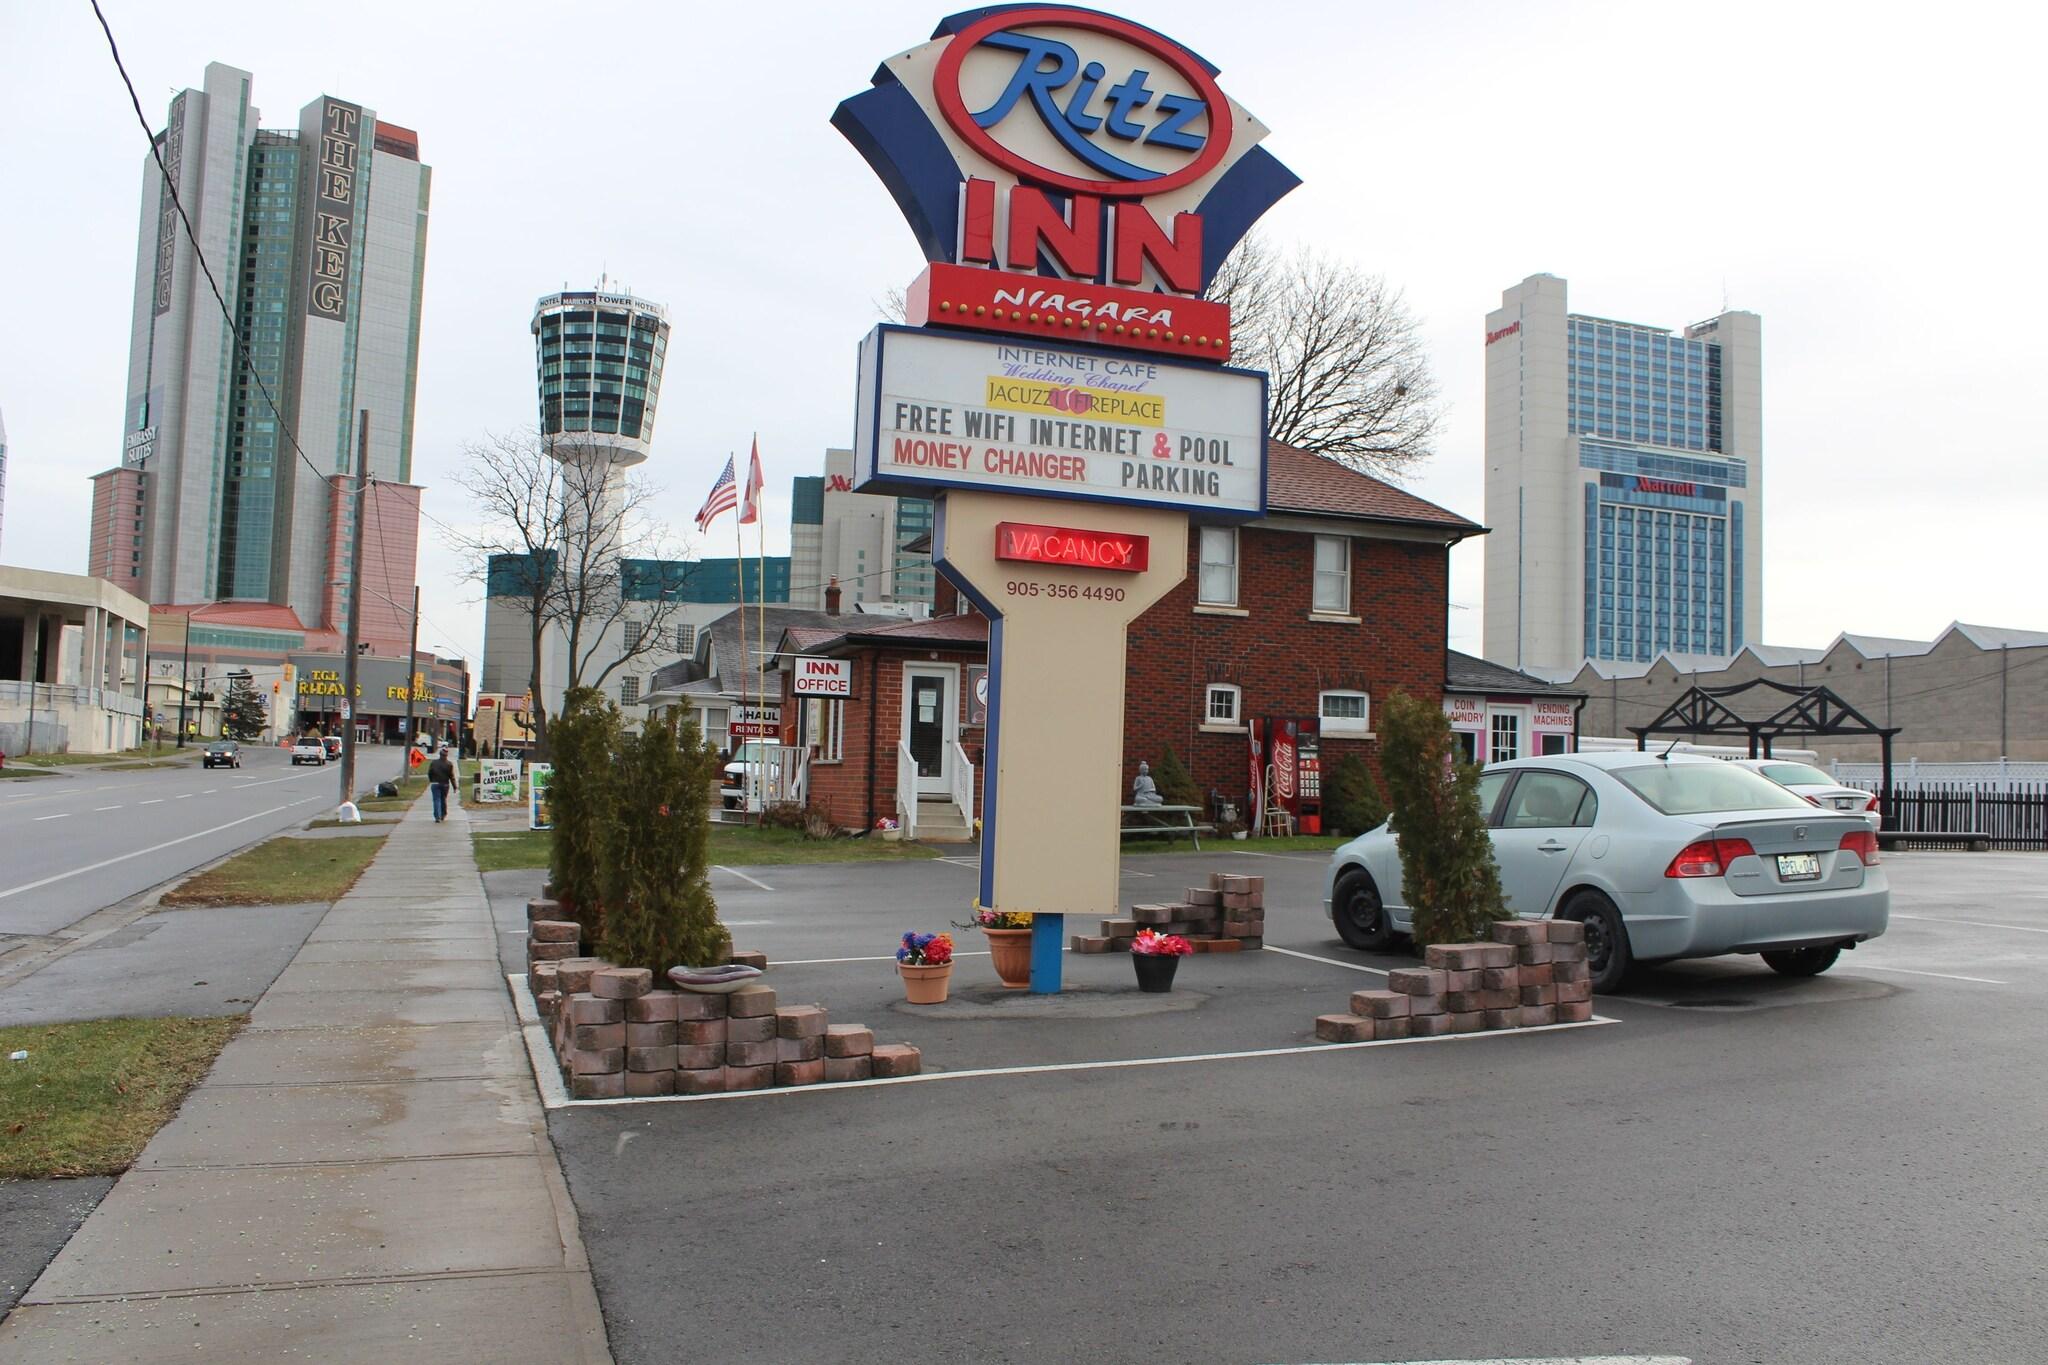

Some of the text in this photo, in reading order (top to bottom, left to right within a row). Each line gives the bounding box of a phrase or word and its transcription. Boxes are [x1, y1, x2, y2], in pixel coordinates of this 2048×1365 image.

[969, 31, 1208, 181] Ritz
[313, 103, 356, 315] THE KEG
[961, 177, 1203, 294] INN
[598, 295, 632, 306] TOWER
[635, 300, 659, 314] HOTEL
[993, 287, 1173, 328] NIAGARA
[1485, 321, 1520, 346] Marriott
[998, 346, 1158, 380] INTERNET CAFE
[1002, 363, 1150, 394] Wedding Chapel
[989, 382, 1162, 419] JACUZZI FIREPLACE
[895, 402, 1234, 466] FREE WIFI INTERNET & POOL
[894, 438, 1219, 497] MONEY CHANGER PARKING
[1633, 477, 1697, 498] Marriott
[1010, 530, 1134, 565] VACANCY
[1006, 581, 1126, 602] 905-356 4490
[806, 662, 839, 675] INN
[797, 678, 848, 692] OFFICE
[1445, 711, 1484, 724] LAUNDRY
[1454, 699, 1475, 711] COIN
[1537, 703, 1570, 714] VENDING
[1533, 715, 1573, 726] MACHINES
[483, 774, 518, 785] CARGO VANS
